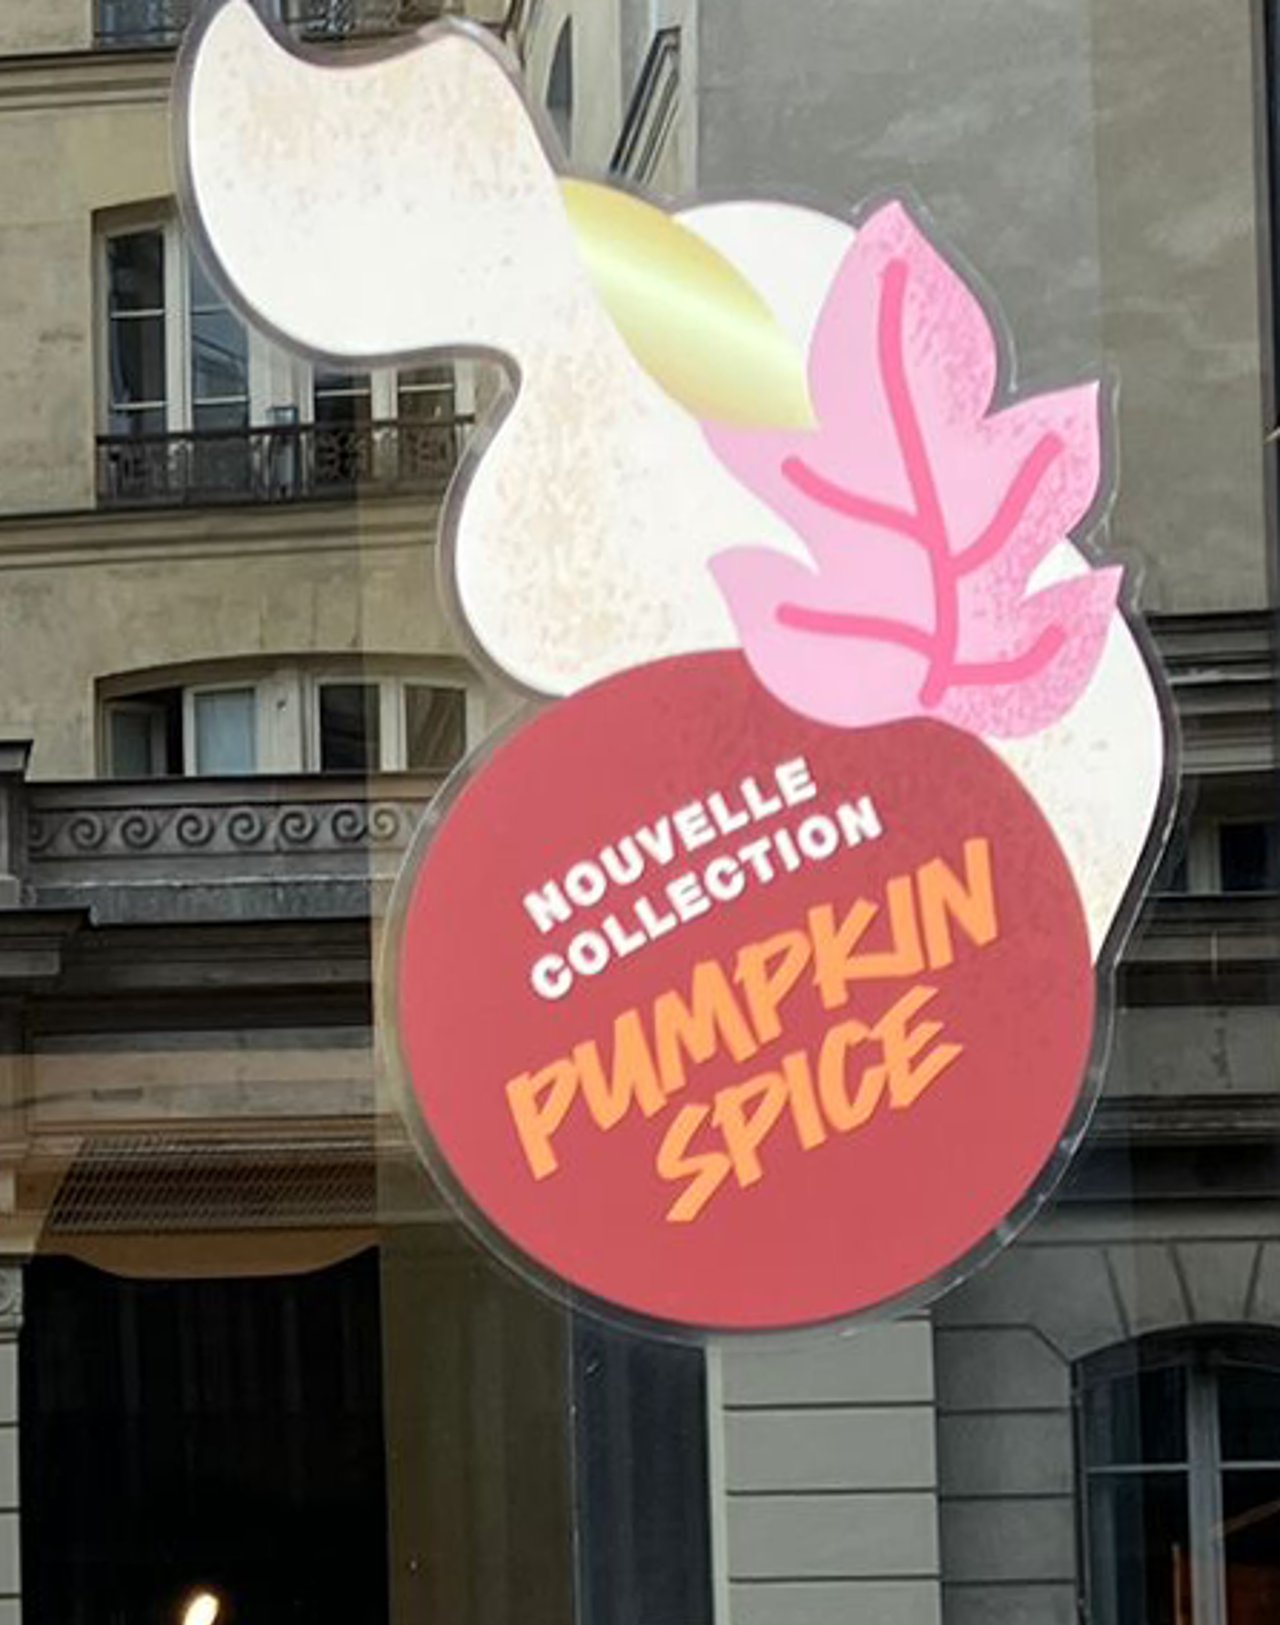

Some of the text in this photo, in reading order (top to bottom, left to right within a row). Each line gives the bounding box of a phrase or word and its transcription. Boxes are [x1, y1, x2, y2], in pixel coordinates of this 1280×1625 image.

[522, 756, 817, 933] NOUVELLE
[530, 795, 882, 1000] COLLECTION
[505, 837, 999, 1181] PUMPKIN
[656, 985, 963, 1222] SPICE
